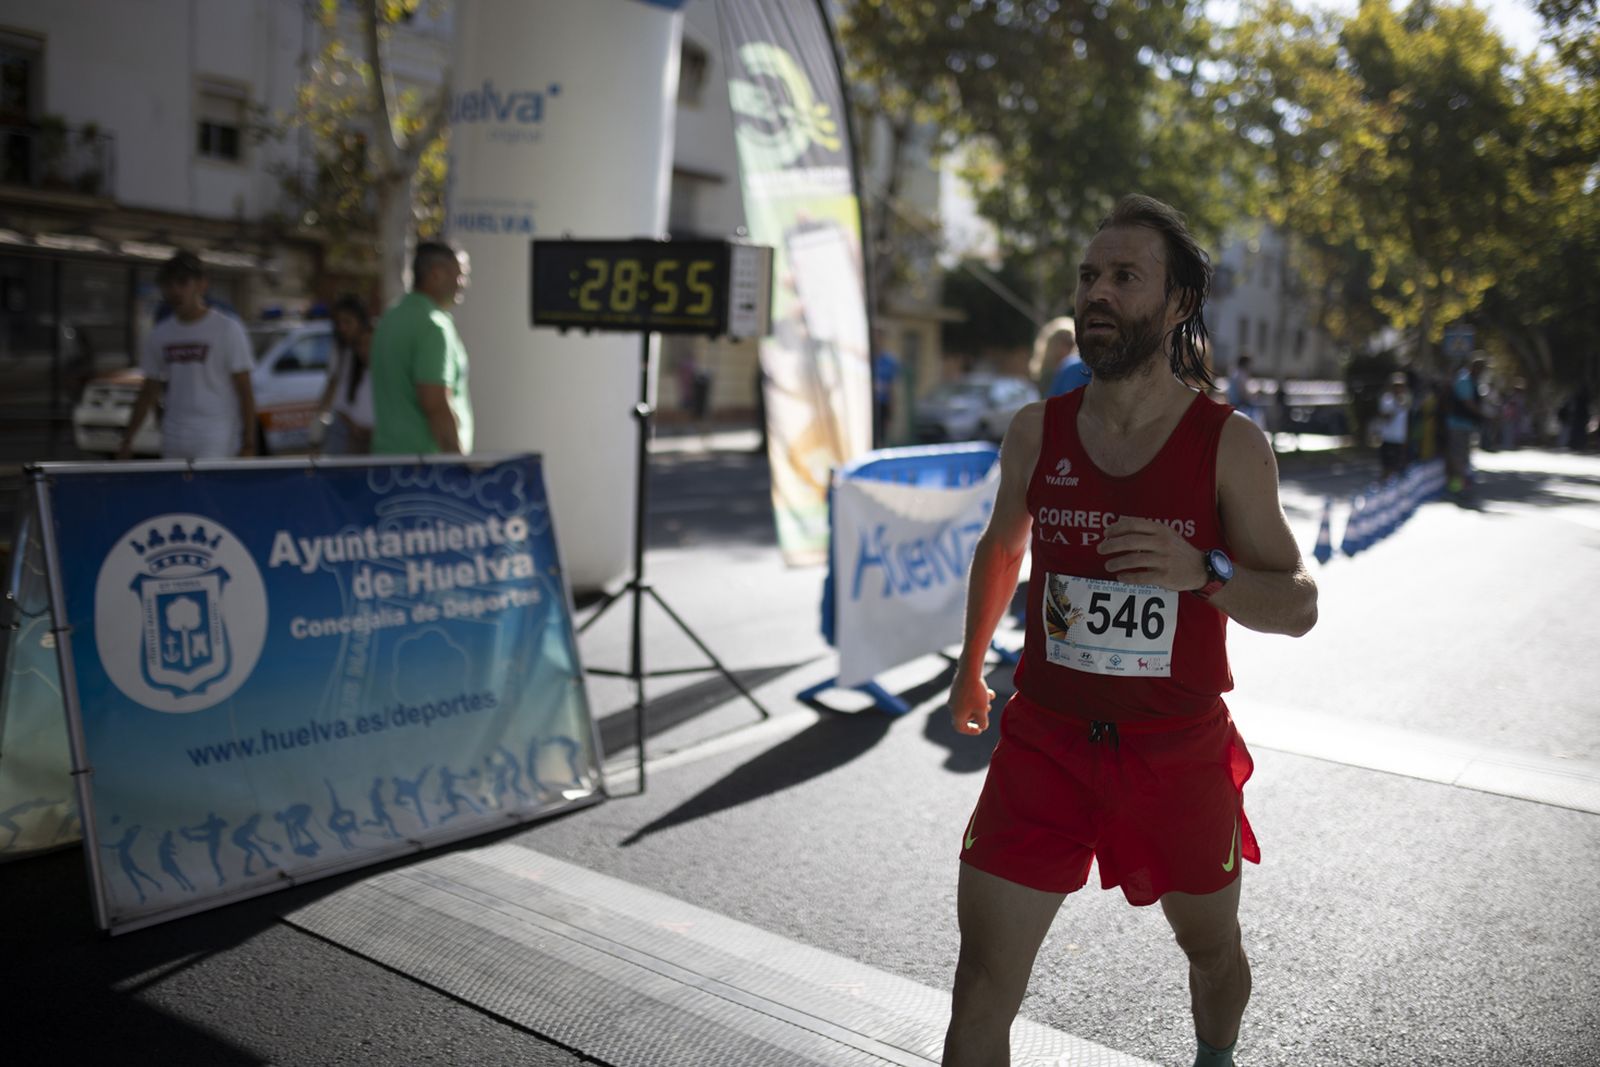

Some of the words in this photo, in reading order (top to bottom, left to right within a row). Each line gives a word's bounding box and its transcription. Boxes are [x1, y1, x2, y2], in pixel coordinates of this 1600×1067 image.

[449, 79, 545, 124] uelva
[1045, 475, 1080, 487] VIATOR
[1038, 506, 1196, 538] CORRECOS
[1038, 527, 1071, 545] LA
[269, 516, 529, 574] Ayuntamiento
[353, 563, 396, 601] de
[406, 552, 534, 595] Huelva
[411, 605, 439, 623] de
[442, 590, 541, 619] Deportes
[1086, 591, 1165, 640] 546
[186, 691, 499, 769] www.huelva.es/deportes
